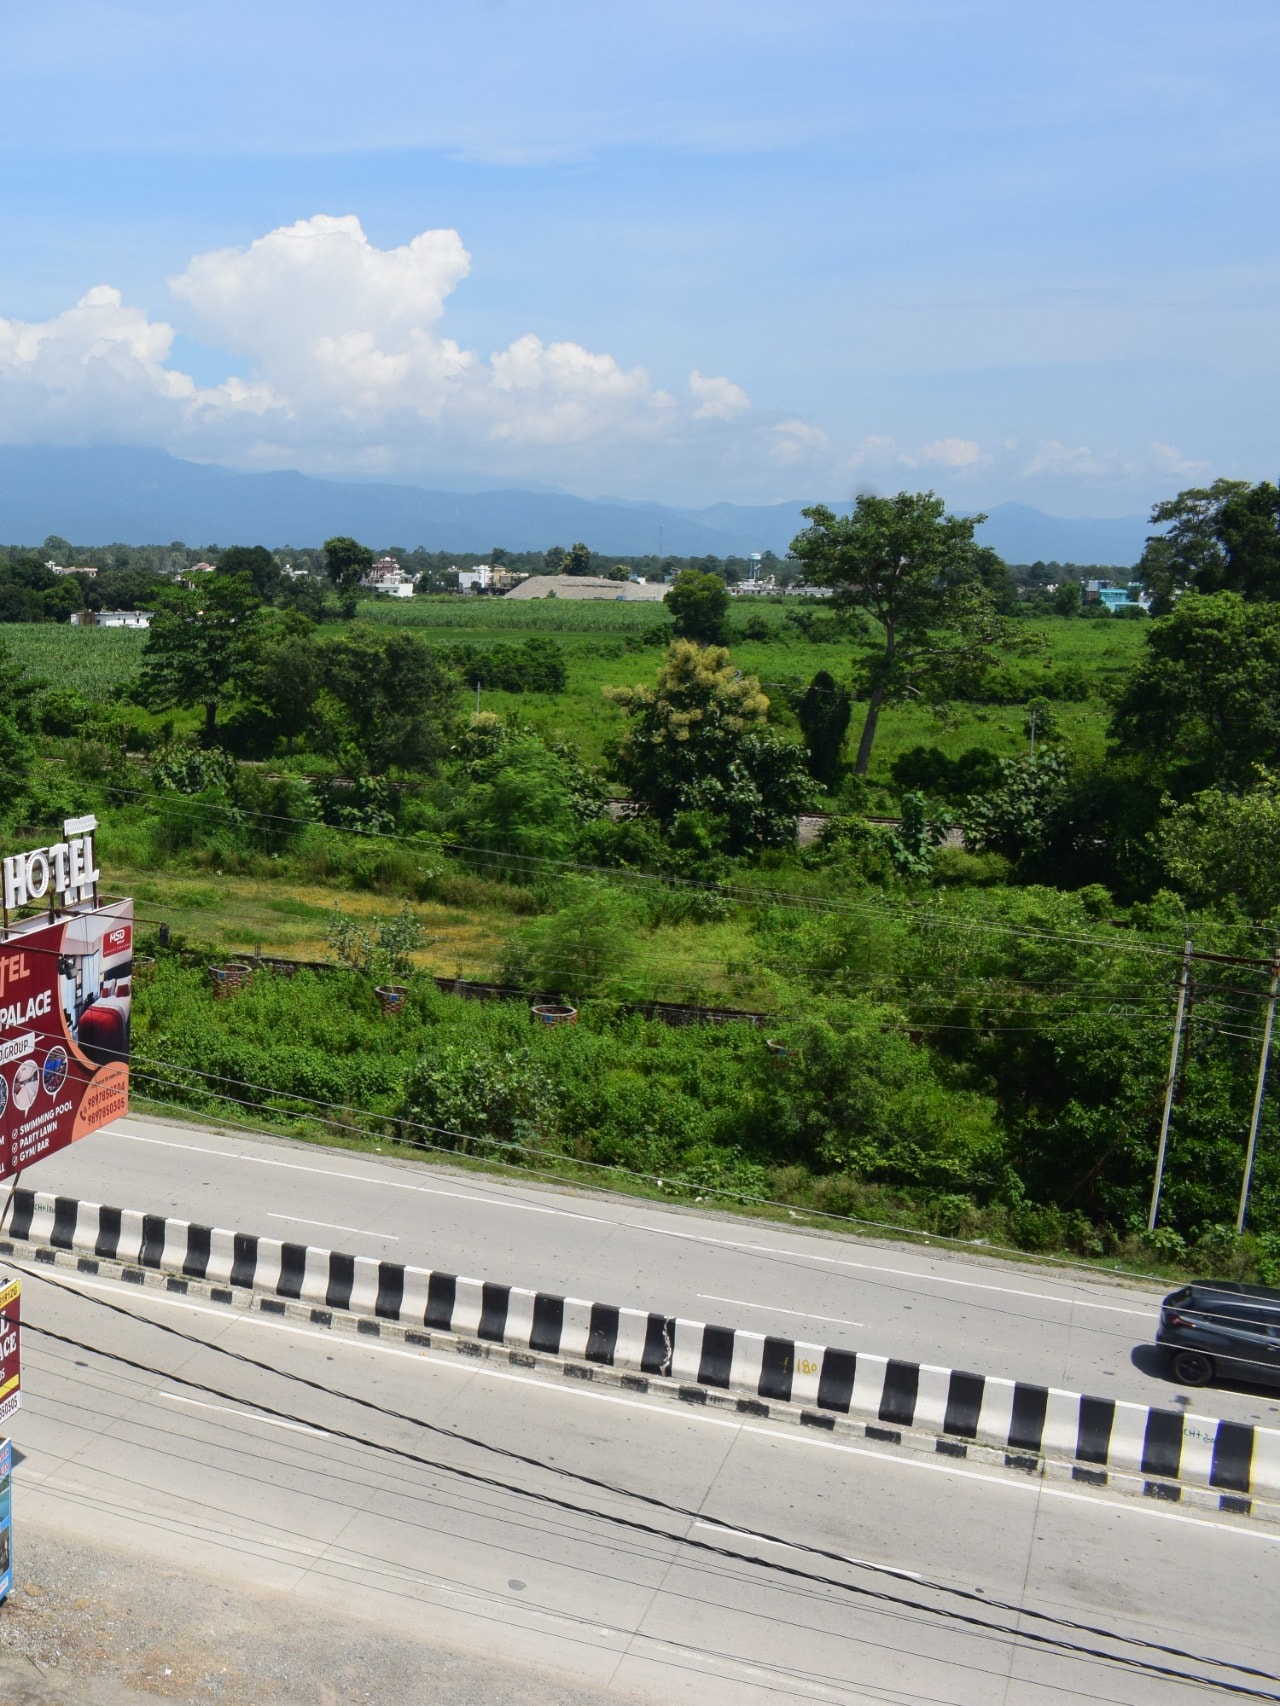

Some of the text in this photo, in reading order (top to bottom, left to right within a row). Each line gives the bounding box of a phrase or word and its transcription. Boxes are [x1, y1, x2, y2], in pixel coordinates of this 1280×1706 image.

[4, 836, 99, 909] HOTEL
[110, 928, 125, 944] MSD
[5, 1039, 28, 1059] GROUP
[19, 1100, 73, 1135] SWIMMING POOL
[19, 1121, 58, 1149] PARTY LAWN
[38, 1139, 50, 1153] BAR
